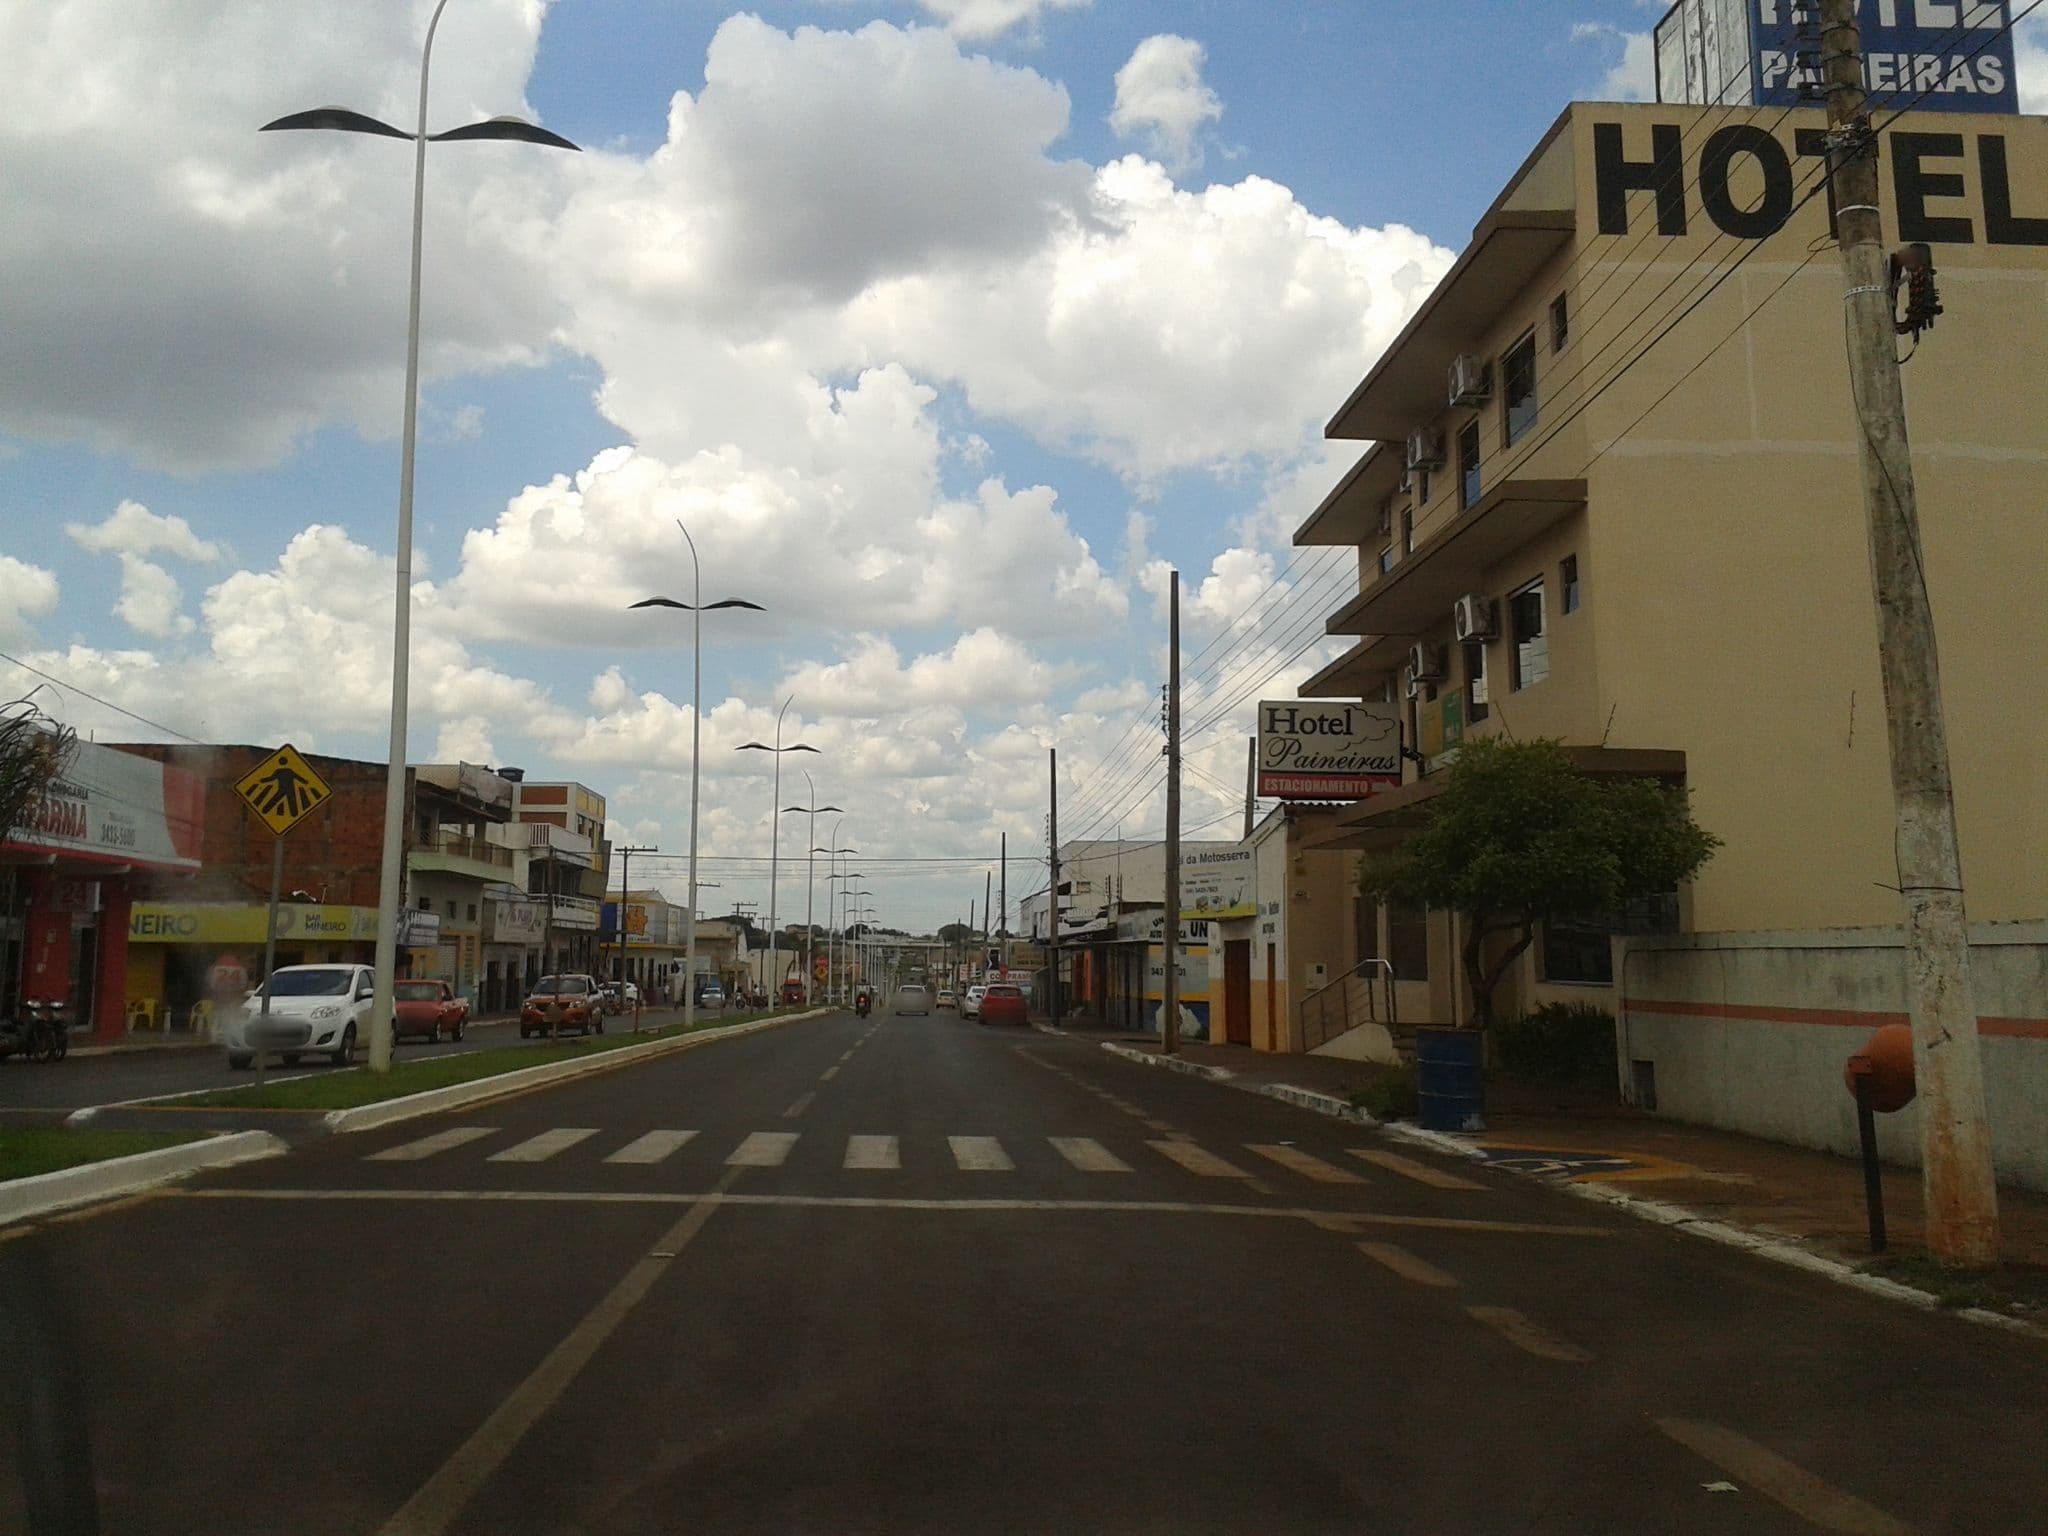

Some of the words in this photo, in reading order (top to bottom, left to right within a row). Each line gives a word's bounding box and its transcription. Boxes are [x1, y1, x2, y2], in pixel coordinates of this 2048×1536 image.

[1761, 50, 2005, 95] PAEIRAS
[1265, 707, 1354, 736] Hotel
[1265, 736, 1396, 771] Paineiras
[1264, 778, 1369, 794] ESTACIONAMENTO
[1186, 855, 1197, 865] da
[1199, 851, 1250, 864] Motosserra
[304, 921, 347, 933] MINEIRO
